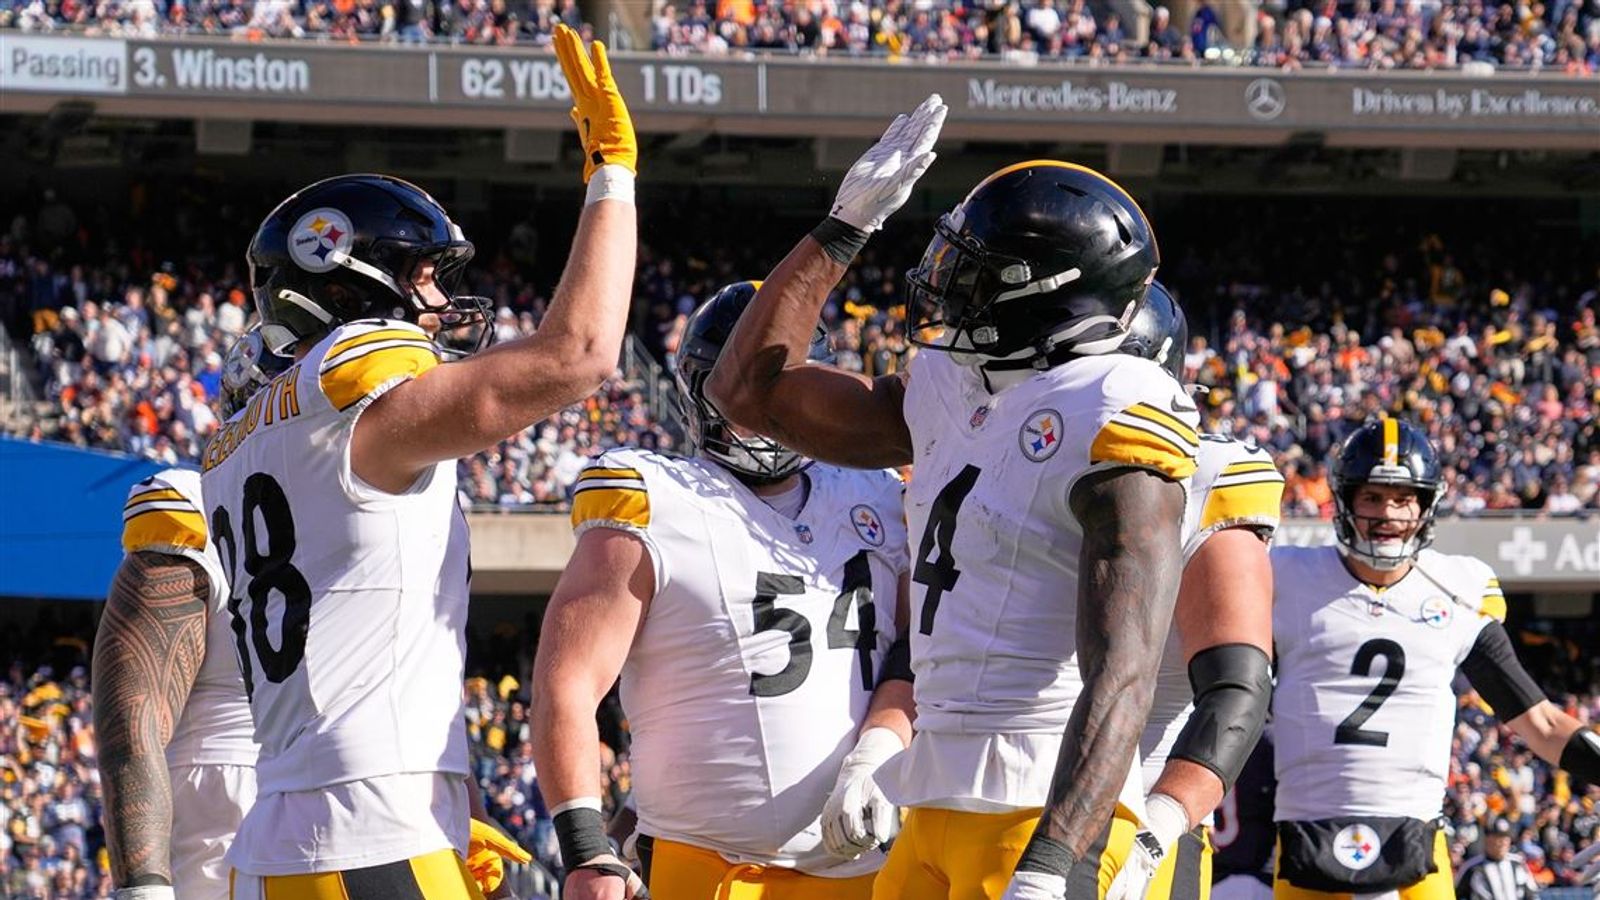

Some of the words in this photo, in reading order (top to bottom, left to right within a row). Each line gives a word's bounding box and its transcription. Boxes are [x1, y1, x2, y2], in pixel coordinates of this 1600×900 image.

[12, 47, 121, 85] Passing
[133, 47, 165, 87] 3.
[171, 48, 309, 92] Winston
[461, 59, 504, 97] 62
[509, 60, 572, 98] YDS
[641, 63, 656, 102] 1
[661, 65, 722, 104] TDs
[967, 78, 1178, 113] Mercedes-Benz
[1352, 87, 1434, 115] Driven
[1437, 87, 1465, 119] by
[912, 463, 982, 636] 4
[748, 549, 877, 698] 54
[1333, 637, 1406, 747] 2
